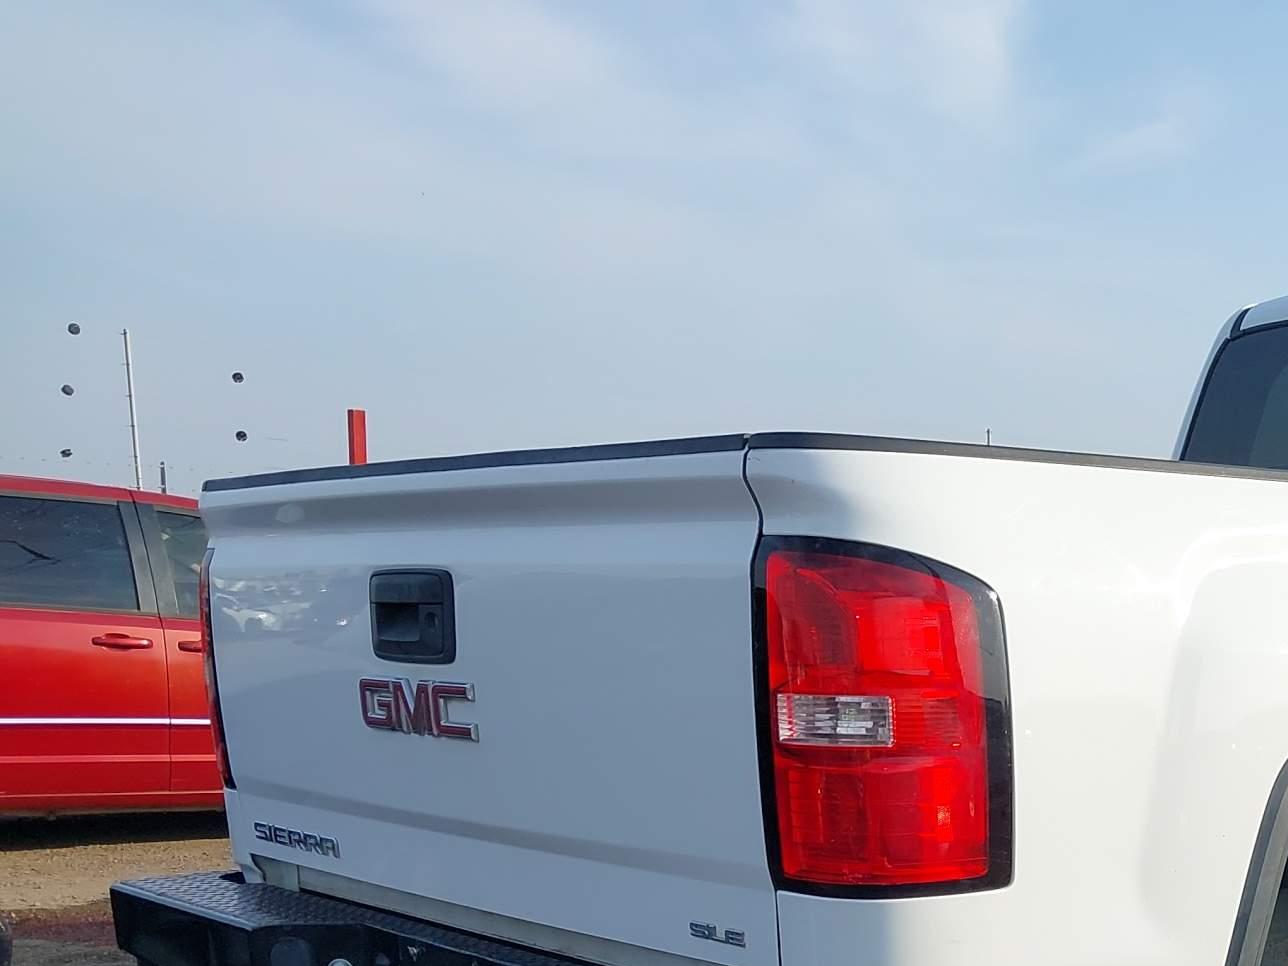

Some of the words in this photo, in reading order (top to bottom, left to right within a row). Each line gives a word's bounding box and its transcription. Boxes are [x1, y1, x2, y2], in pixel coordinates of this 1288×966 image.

[358, 676, 479, 743] GMC
[253, 821, 341, 860] SIERRA
[689, 921, 746, 949] SLE
